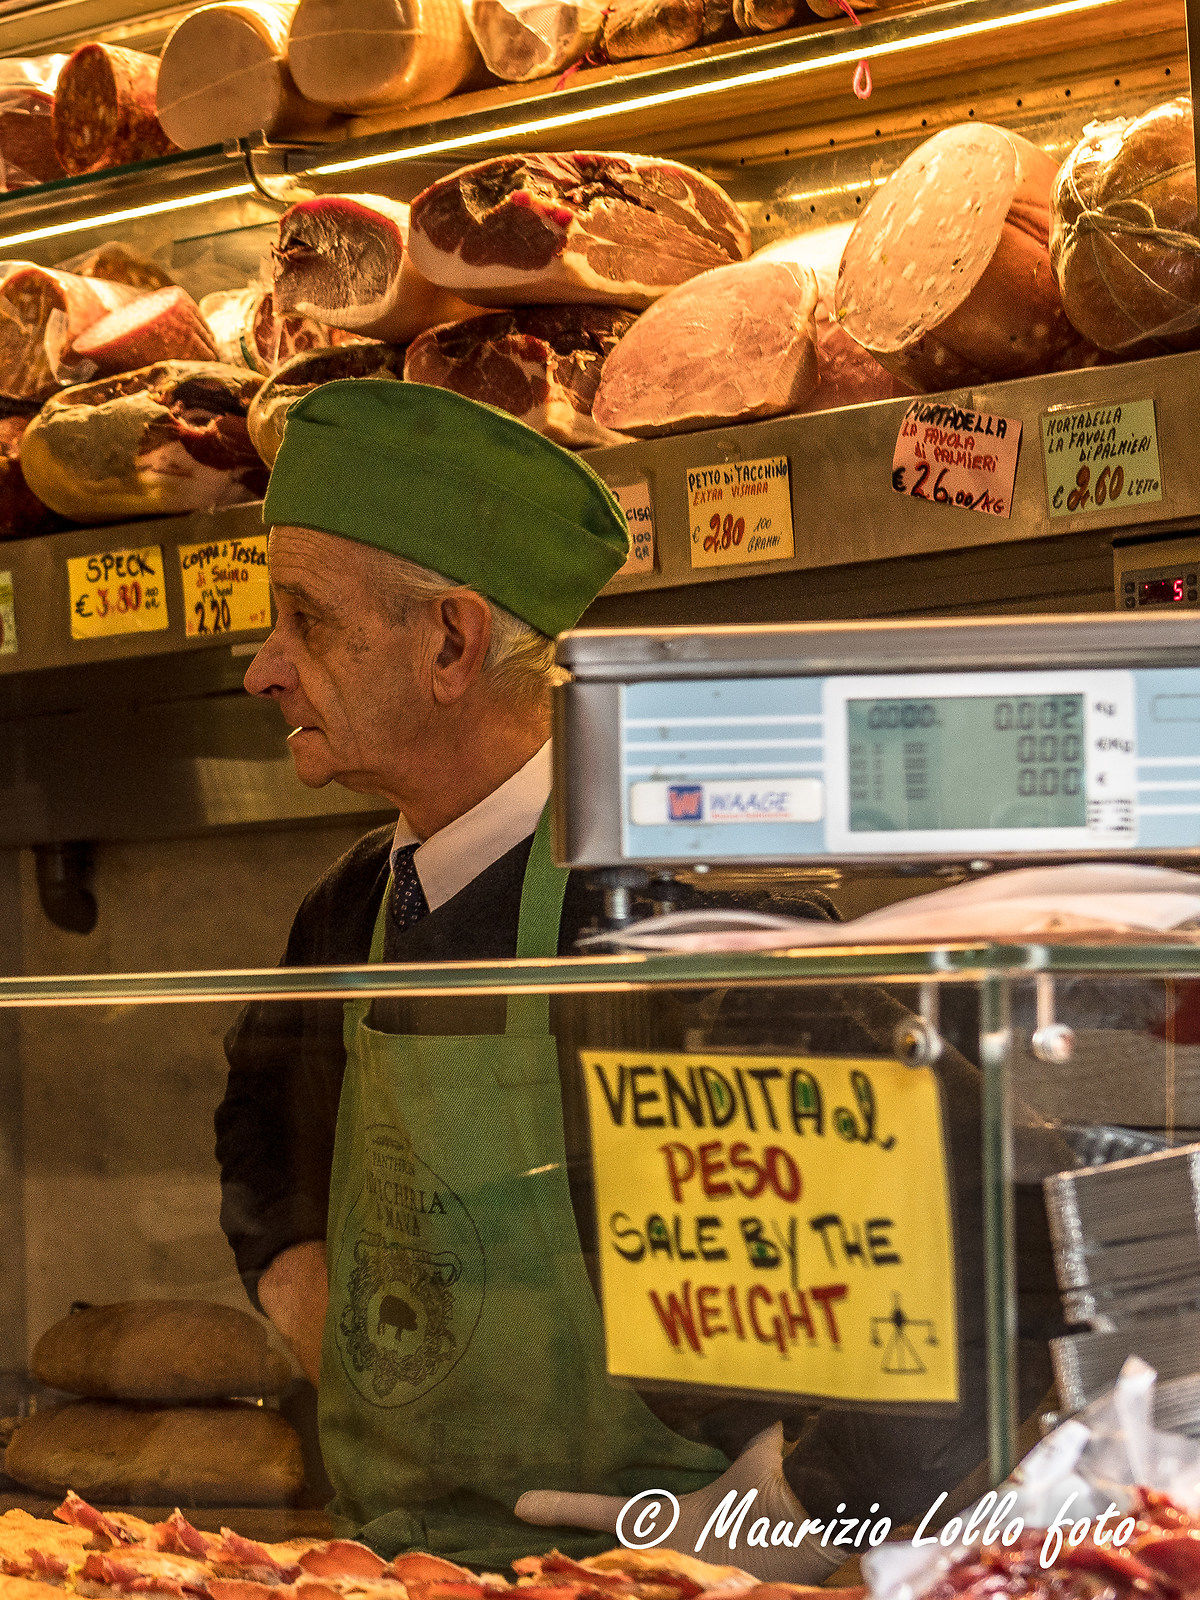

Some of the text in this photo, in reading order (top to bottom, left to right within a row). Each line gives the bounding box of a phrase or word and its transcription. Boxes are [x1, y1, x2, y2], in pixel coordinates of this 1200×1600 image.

[902, 421, 975, 450] LA FAVOLA
[904, 401, 1008, 439] MORTADELLA
[1047, 407, 1122, 437] MORTADELLA
[1048, 427, 1116, 454] LA FAVOLA
[86, 554, 155, 583] SPECK
[1173, 579, 1183, 601] 5
[594, 1063, 825, 1137] VENDITA
[659, 1141, 803, 1203] PESO
[609, 1211, 729, 1263] SALE
[809, 1213, 901, 1268] THE
[648, 1281, 849, 1358] WEIGHT
